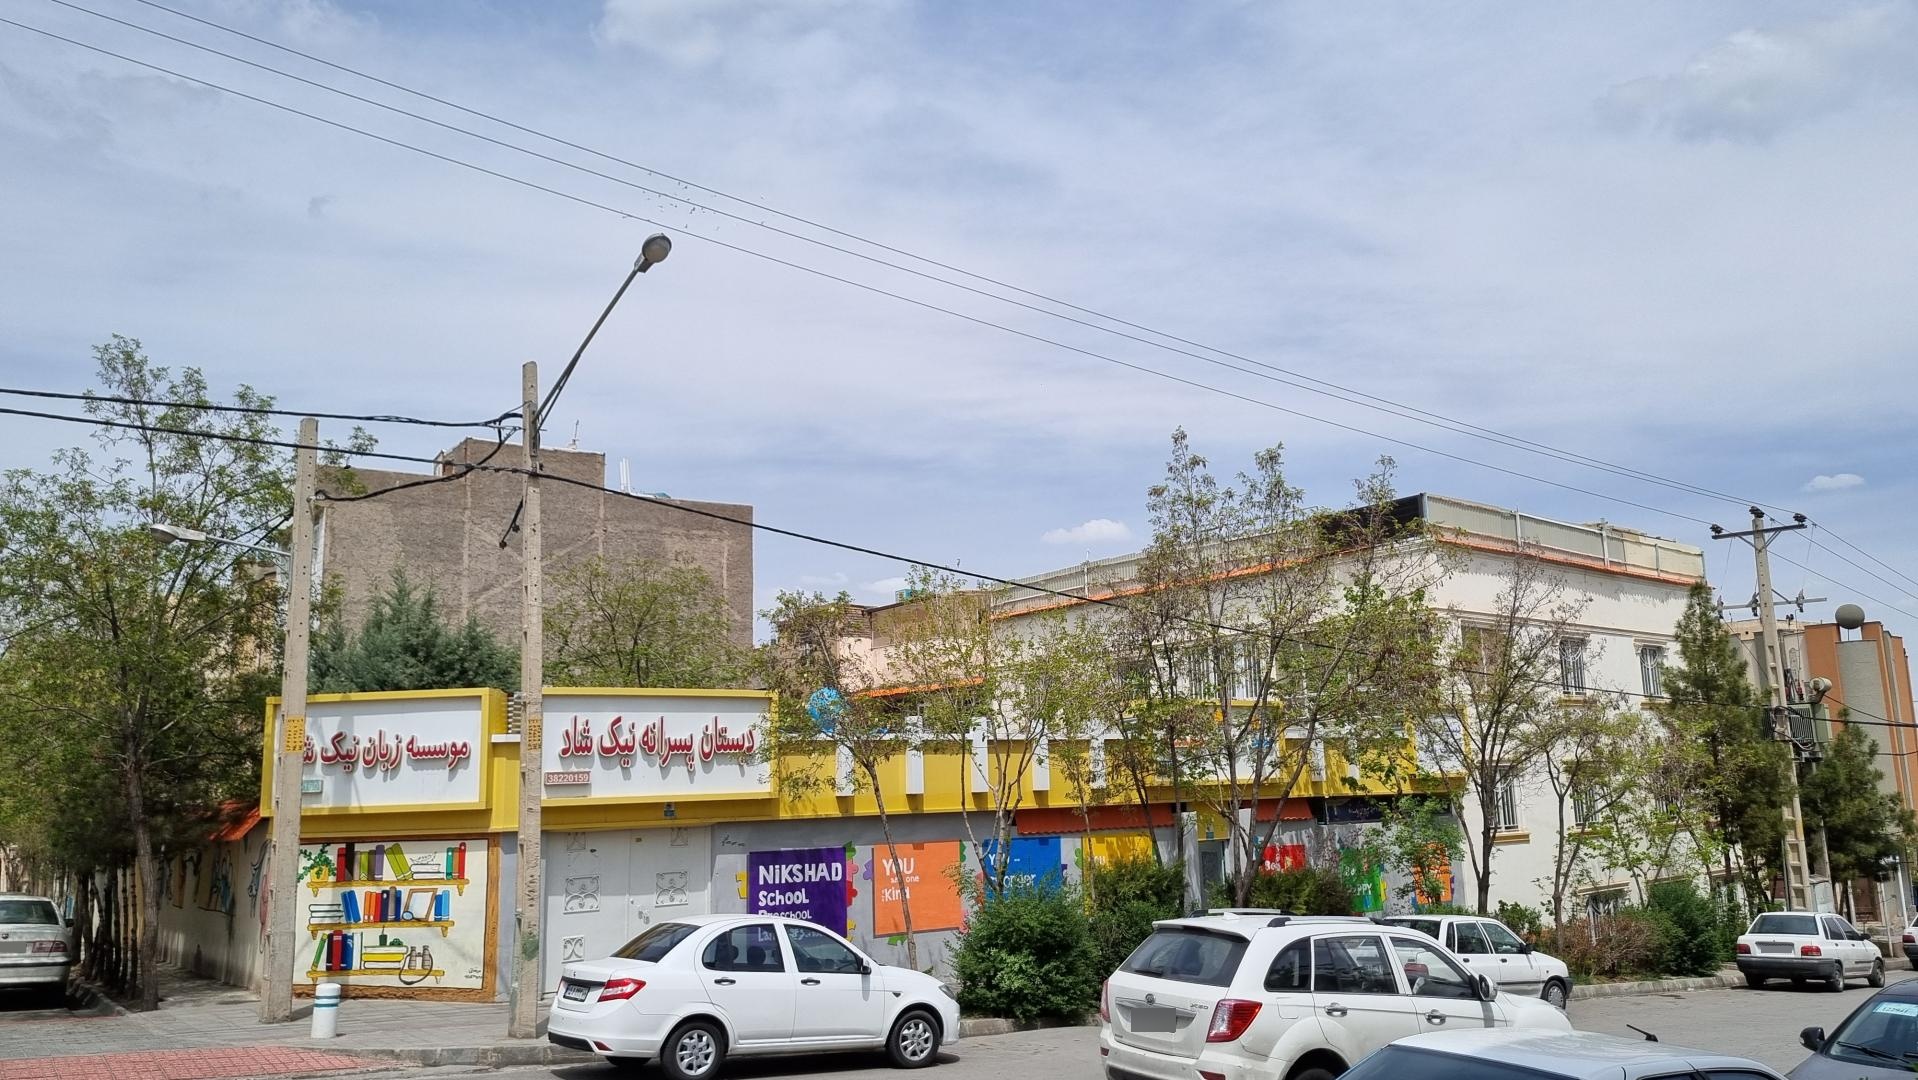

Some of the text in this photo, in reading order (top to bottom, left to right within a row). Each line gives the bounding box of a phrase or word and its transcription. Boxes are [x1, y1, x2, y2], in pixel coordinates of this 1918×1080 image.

[320, 731, 360, 771] نیک
[362, 729, 402, 771] زبان
[406, 735, 471, 770] موسسه
[559, 714, 594, 758] شاد
[599, 715, 637, 767] نیک
[639, 716, 696, 772] پسرانه
[700, 715, 756, 764] دبستان
[548, 773, 589, 783] 38220159
